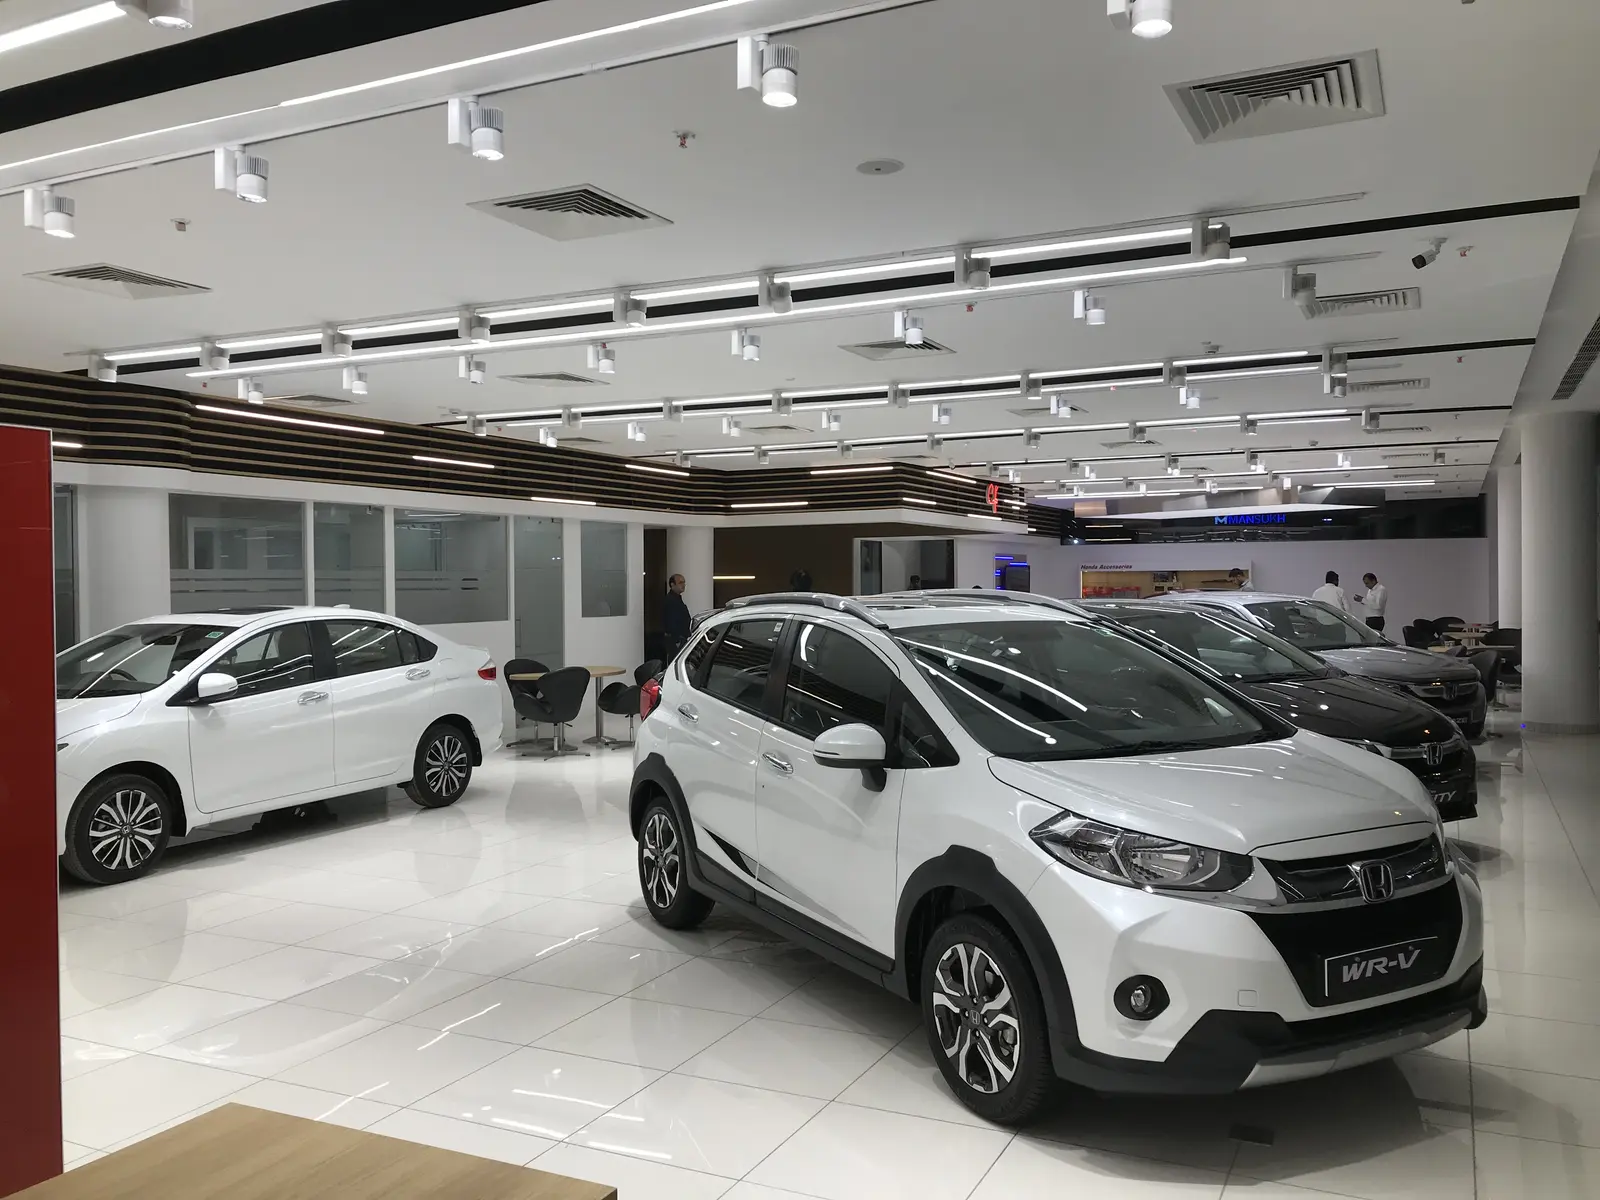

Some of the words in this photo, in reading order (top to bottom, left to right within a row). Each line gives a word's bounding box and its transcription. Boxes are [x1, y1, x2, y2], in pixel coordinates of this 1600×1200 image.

[1228, 513, 1287, 525] MANSUKH
[1433, 790, 1457, 803] ITY
[1342, 949, 1421, 983] WR-V
